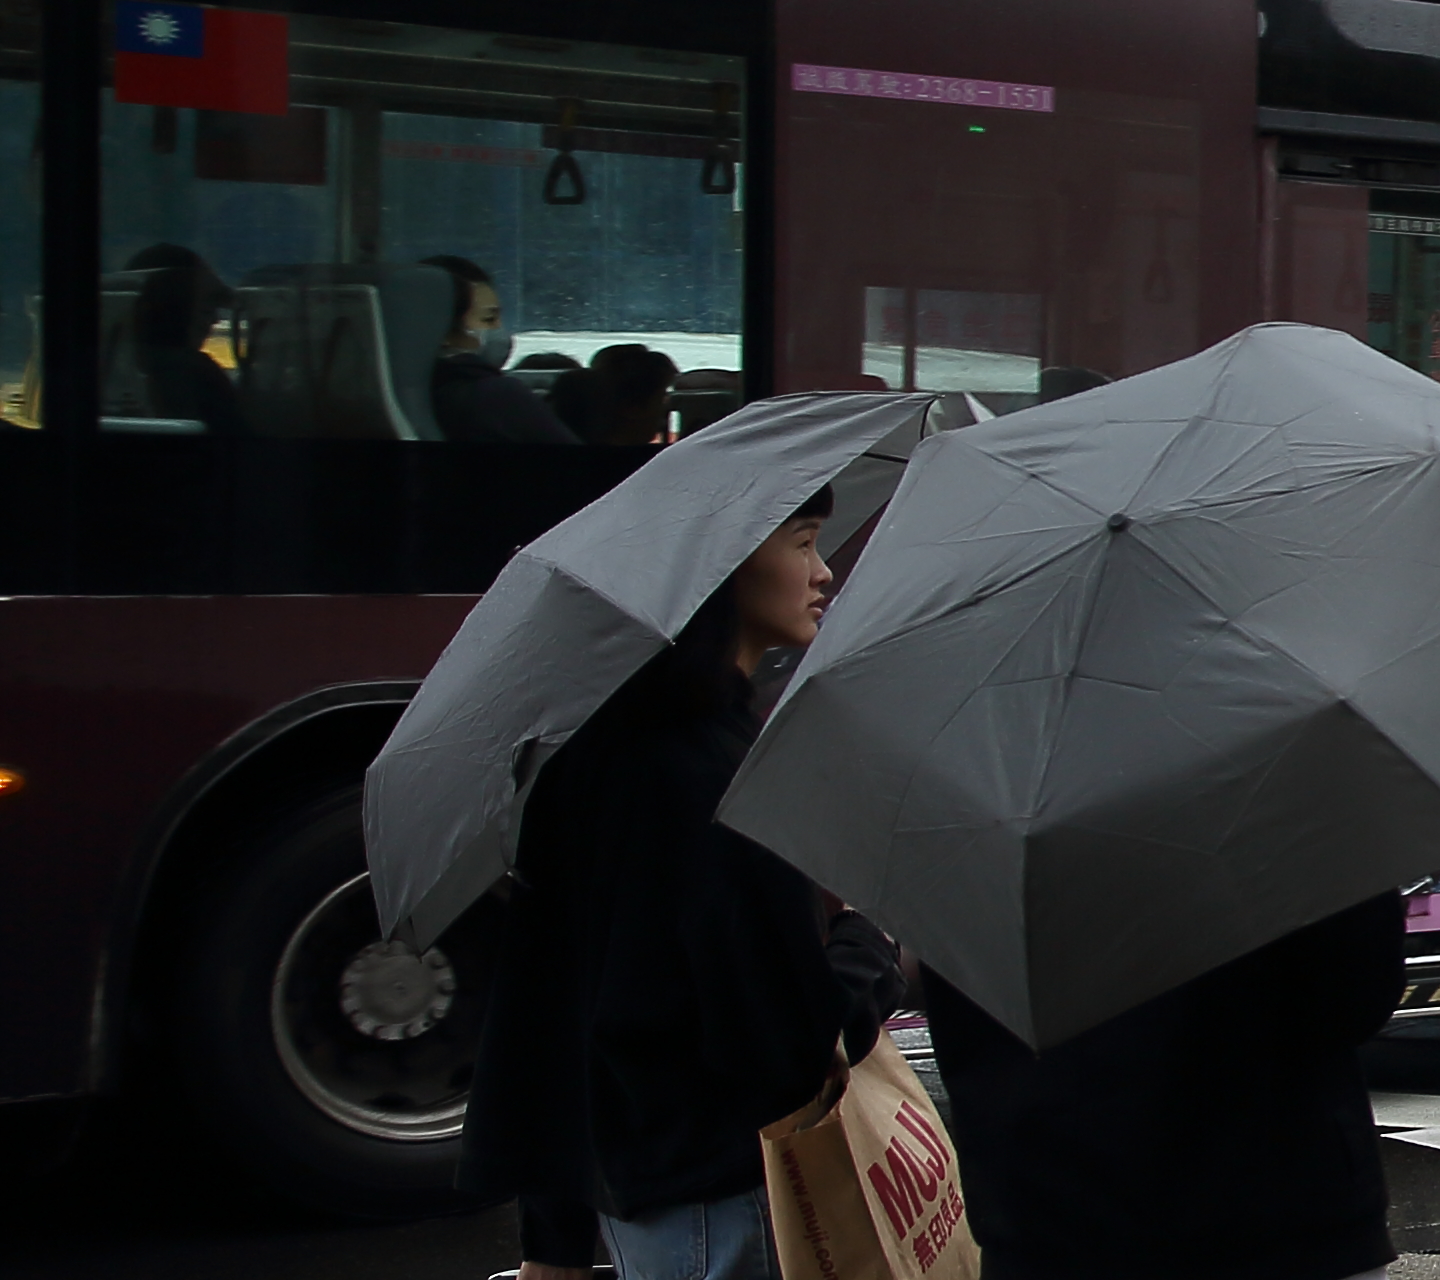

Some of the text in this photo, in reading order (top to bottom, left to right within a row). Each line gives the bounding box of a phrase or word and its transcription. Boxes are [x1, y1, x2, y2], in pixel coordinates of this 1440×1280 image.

[867, 1100, 951, 1241] MUJI
[912, 1180, 965, 1274] 無印良品
